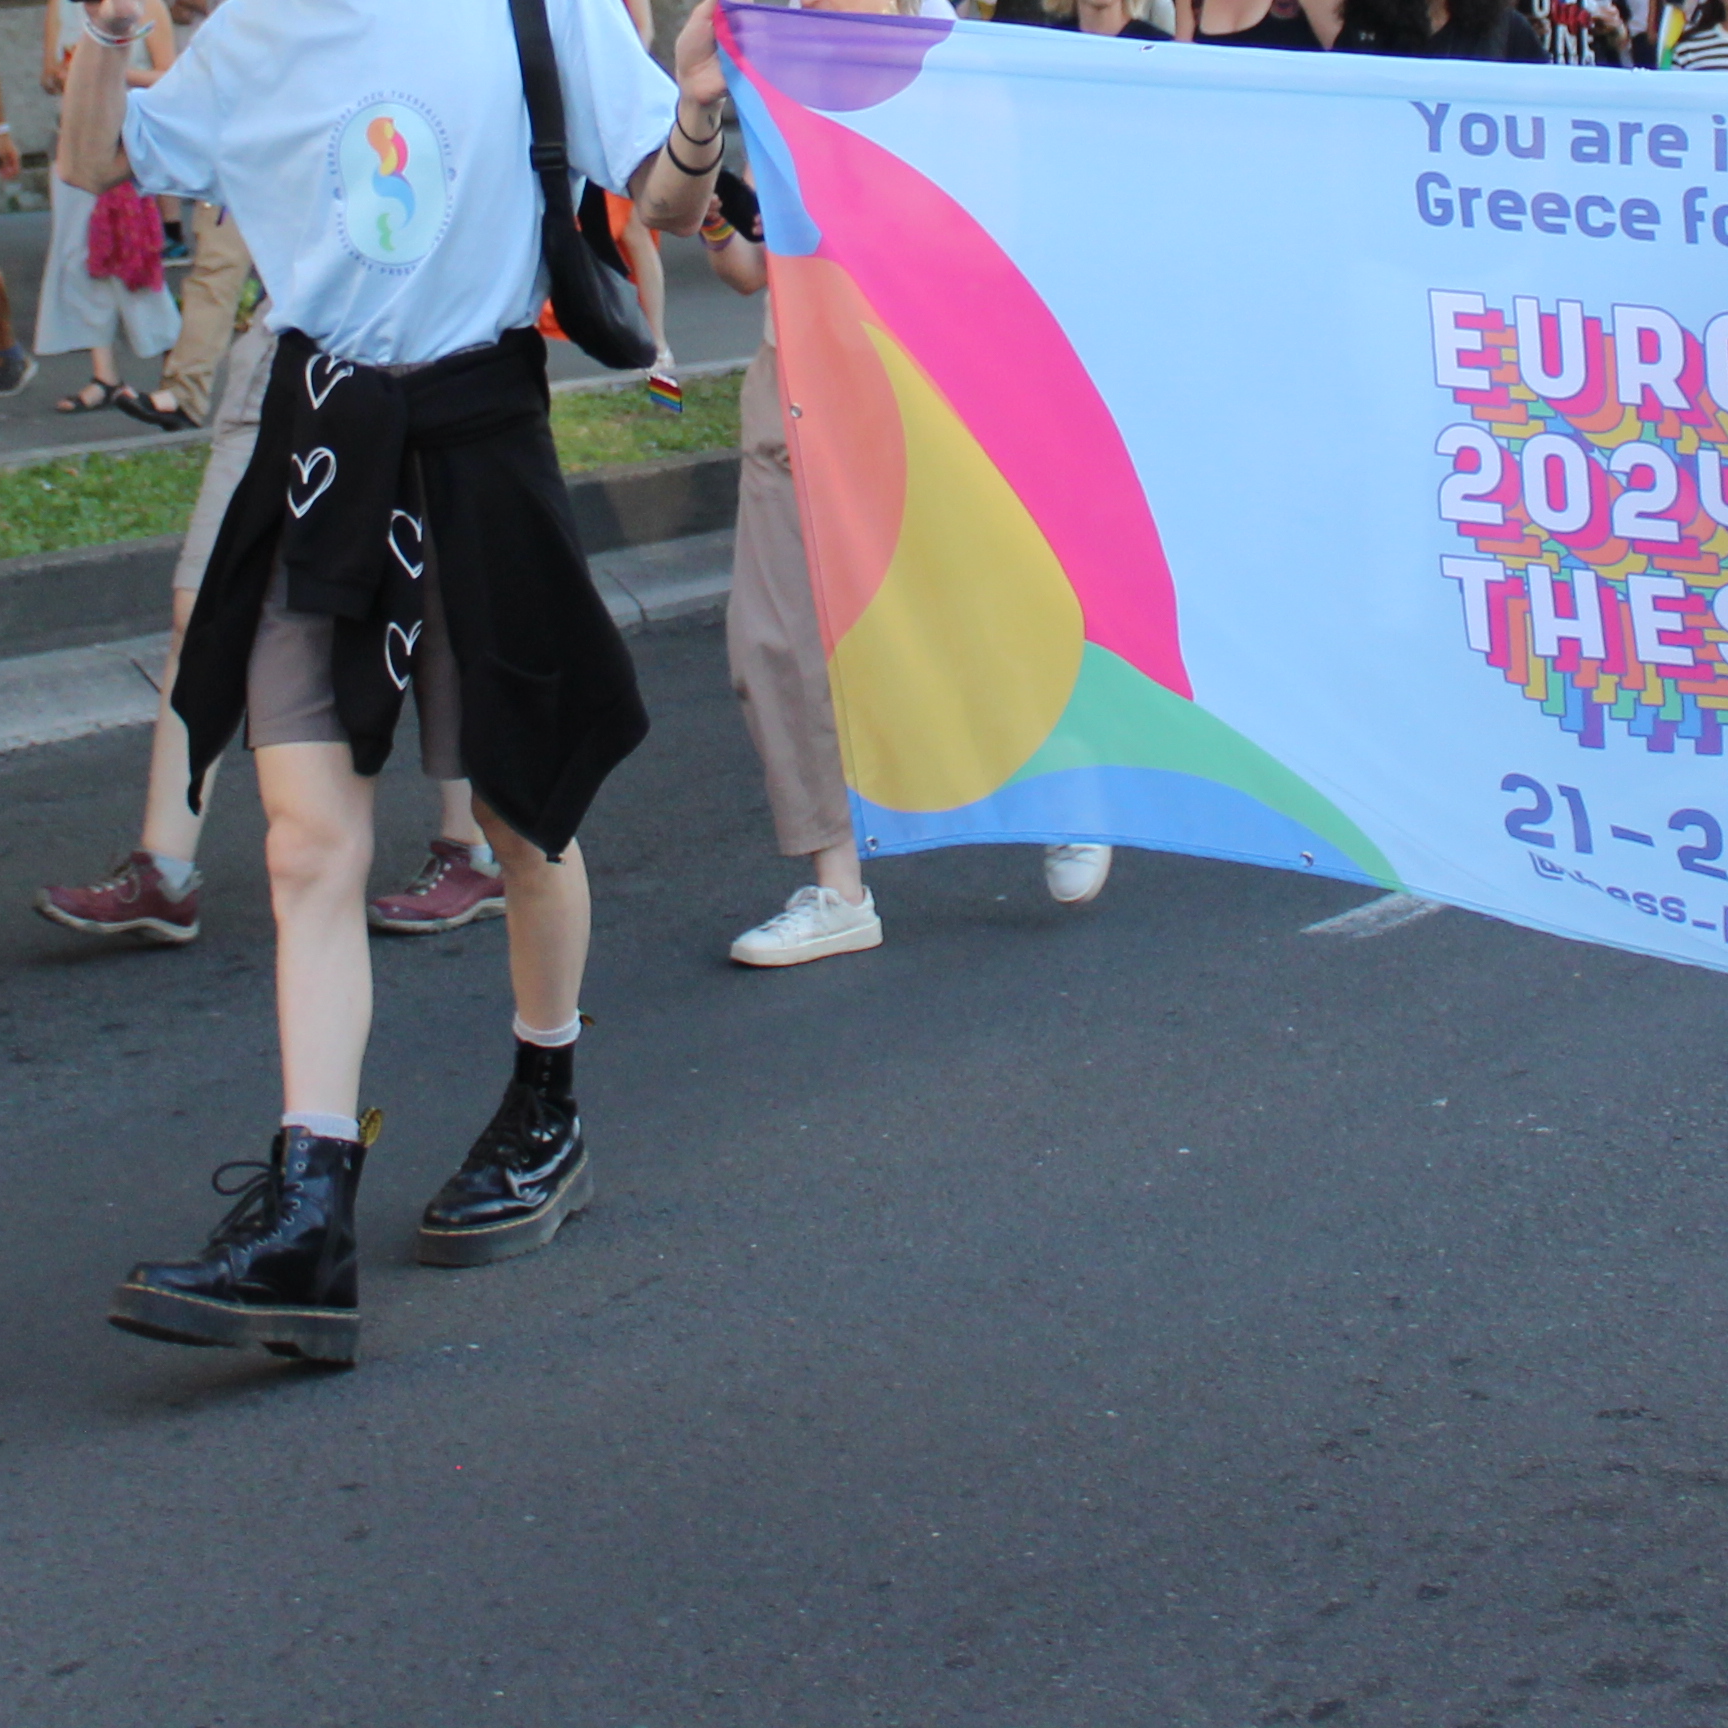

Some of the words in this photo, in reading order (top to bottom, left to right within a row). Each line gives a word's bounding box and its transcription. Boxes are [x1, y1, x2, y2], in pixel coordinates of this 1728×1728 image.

[1409, 101, 1546, 160] You
[1570, 119, 1690, 168] are
[1415, 170, 1662, 242] Greece
